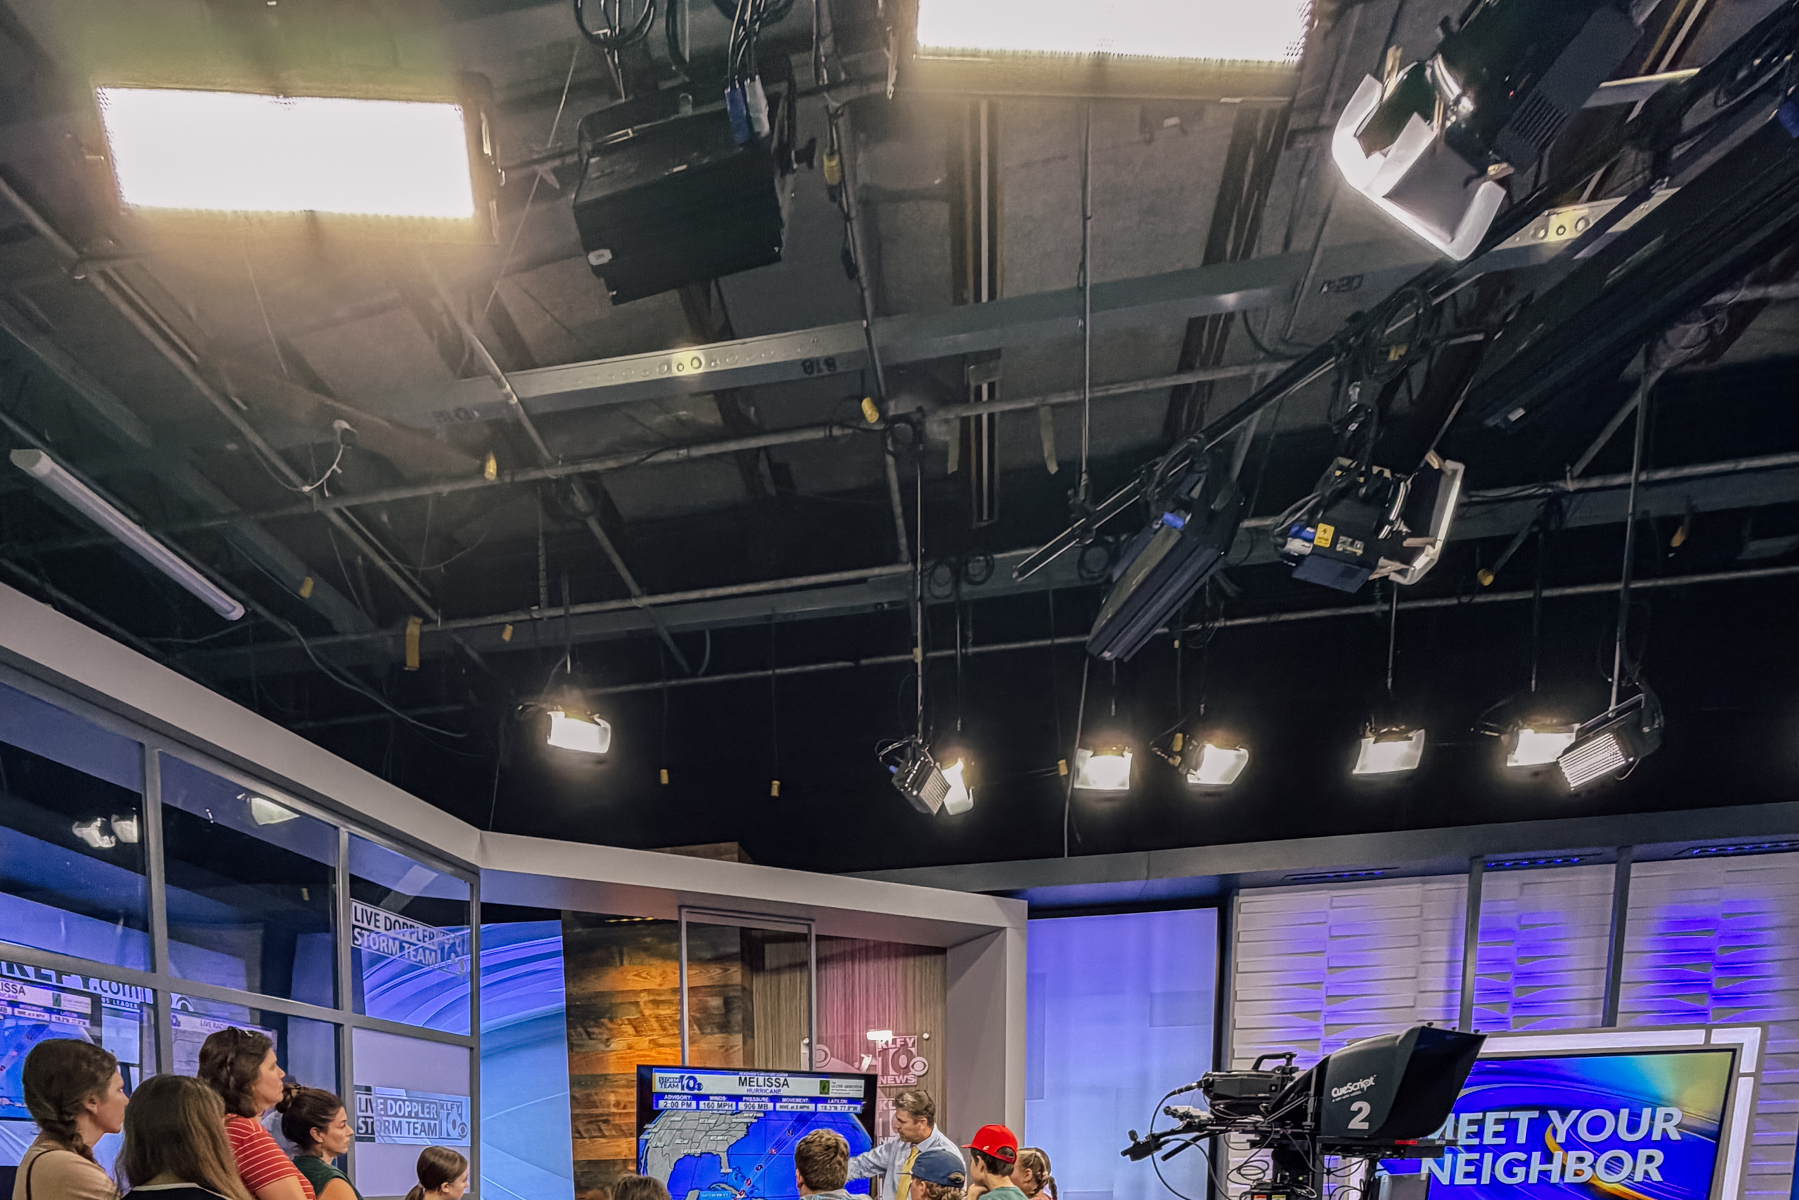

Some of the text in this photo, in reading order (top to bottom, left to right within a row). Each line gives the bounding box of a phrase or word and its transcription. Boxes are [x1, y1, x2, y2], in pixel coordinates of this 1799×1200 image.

[354, 904, 436, 946] LIVE DOPPLER
[353, 926, 400, 956] STORM
[402, 942, 436, 966] TEAM
[200, 1019, 212, 1028] LIVE
[878, 1037, 915, 1049] KLFY
[878, 1049, 915, 1076] 10
[679, 1075, 698, 1091] 10
[738, 1076, 790, 1089] MELISSA
[878, 1074, 916, 1085] NEWS
[1331, 1076, 1375, 1098] CueScript
[746, 1087, 782, 1095] HURRICANE
[358, 1096, 437, 1119] LIVE DOPPLER
[440, 1101, 462, 1113] KLFY
[880, 1101, 897, 1110] KL
[1348, 1101, 1370, 1129] 2
[358, 1117, 437, 1137] STORM TEAM
[1548, 1107, 1682, 1143] YOUR
[1421, 1149, 1664, 1185] NEIGHBOR
